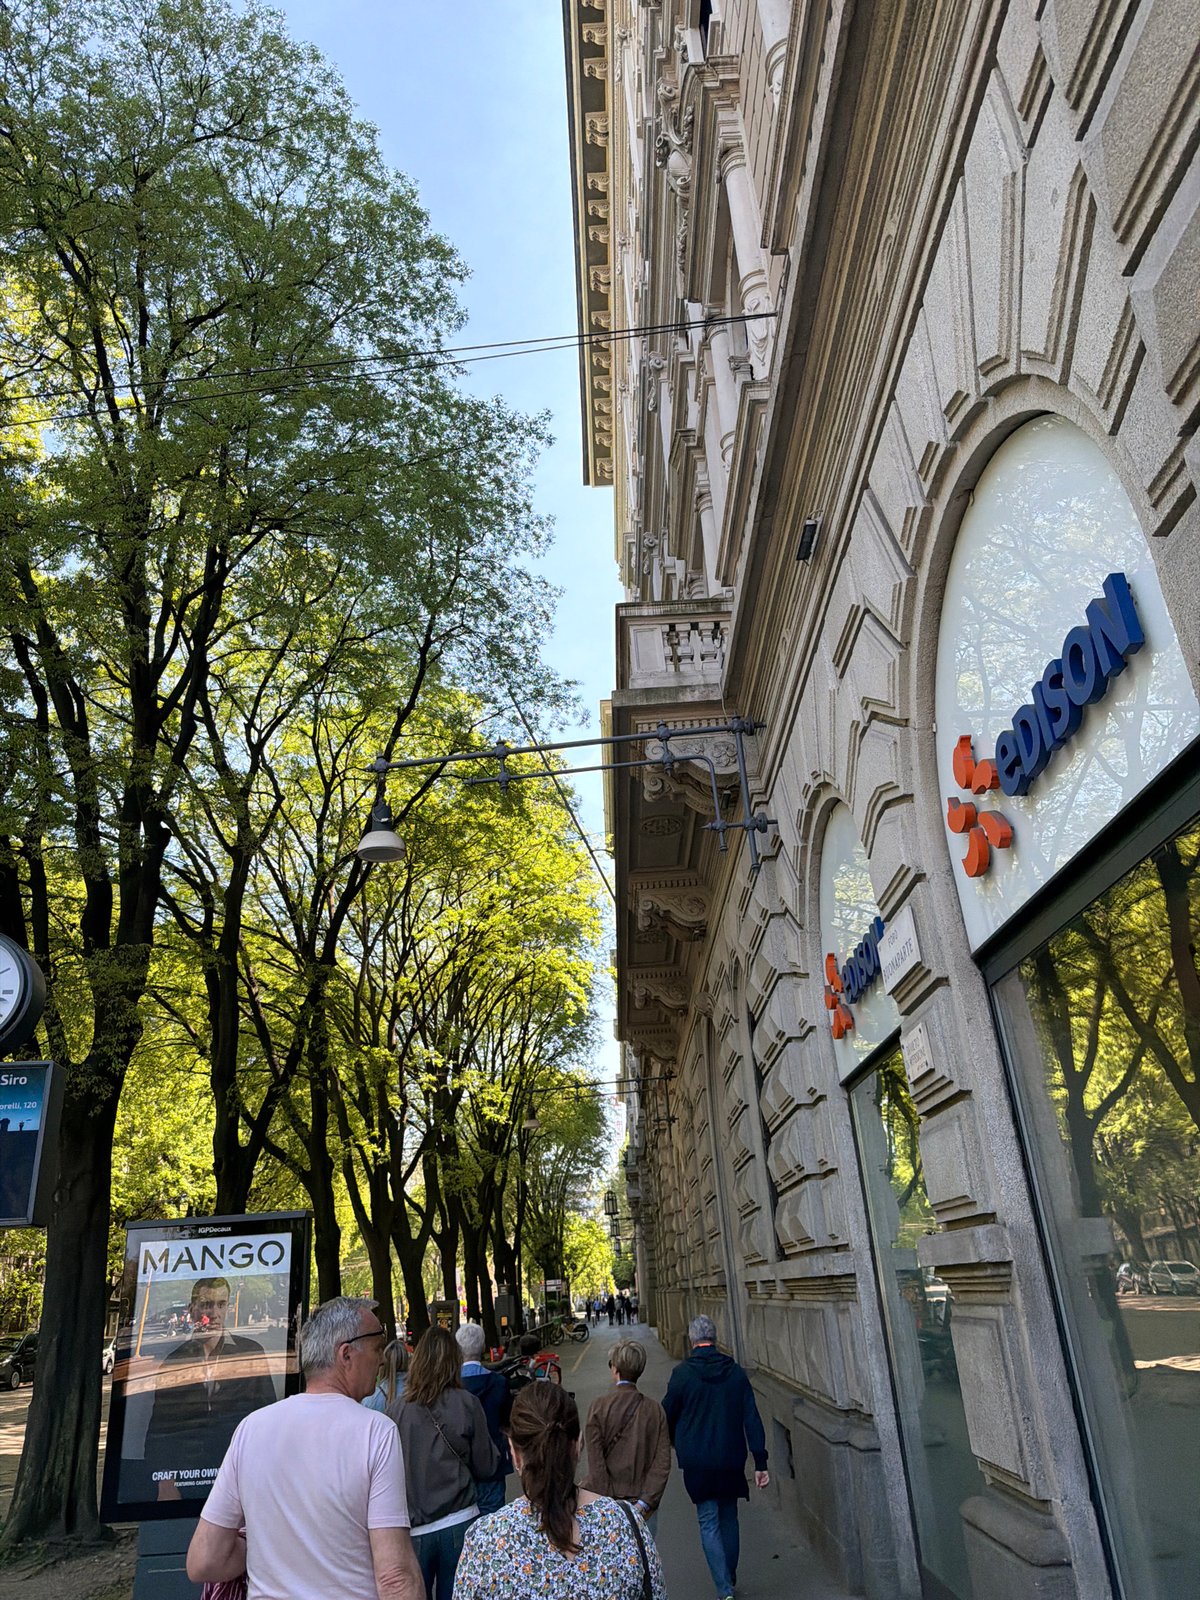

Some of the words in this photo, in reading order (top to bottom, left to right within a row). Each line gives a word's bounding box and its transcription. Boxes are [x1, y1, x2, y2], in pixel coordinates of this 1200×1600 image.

[887, 929, 898, 948] FORO
[0, 1074, 28, 1086] Siro
[23, 1101, 37, 1109] 120
[198, 1226, 232, 1234] IGPDecaux
[143, 1240, 285, 1275] MANGO
[152, 1470, 178, 1481] CRAFT
[179, 1469, 200, 1479] YOUR
[201, 1468, 220, 1478] OWN
